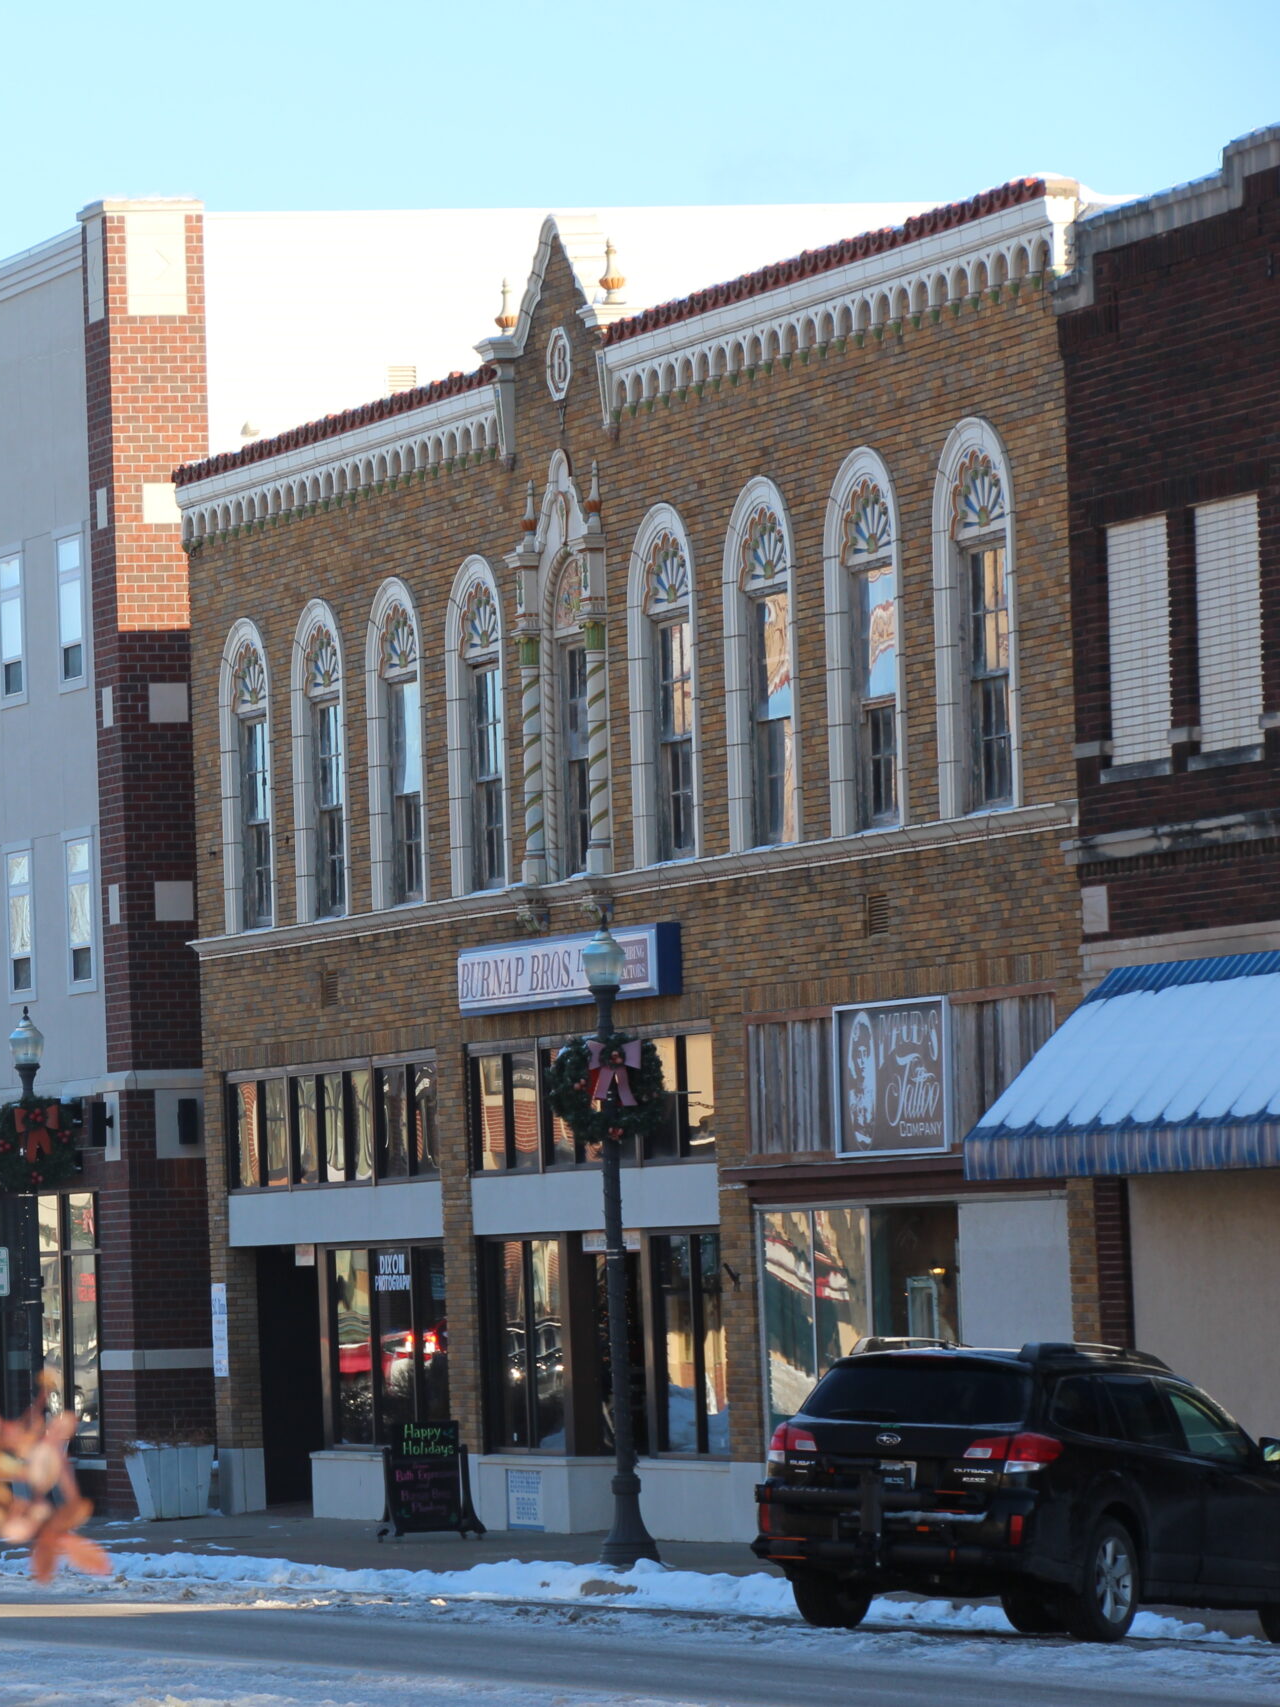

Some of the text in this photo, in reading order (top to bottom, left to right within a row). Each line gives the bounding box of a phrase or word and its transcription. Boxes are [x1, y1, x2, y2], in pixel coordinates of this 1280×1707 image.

[461, 957, 525, 1000] BURNAP
[529, 950, 575, 992] BROS.
[621, 963, 647, 979] ACTORS
[885, 1053, 940, 1127] Tattoo
[379, 1253, 405, 1274] DIXON
[374, 1274, 411, 1292] PHOTOGRAPH
[403, 1423, 441, 1442] Happy
[402, 1440, 455, 1457] Holidays
